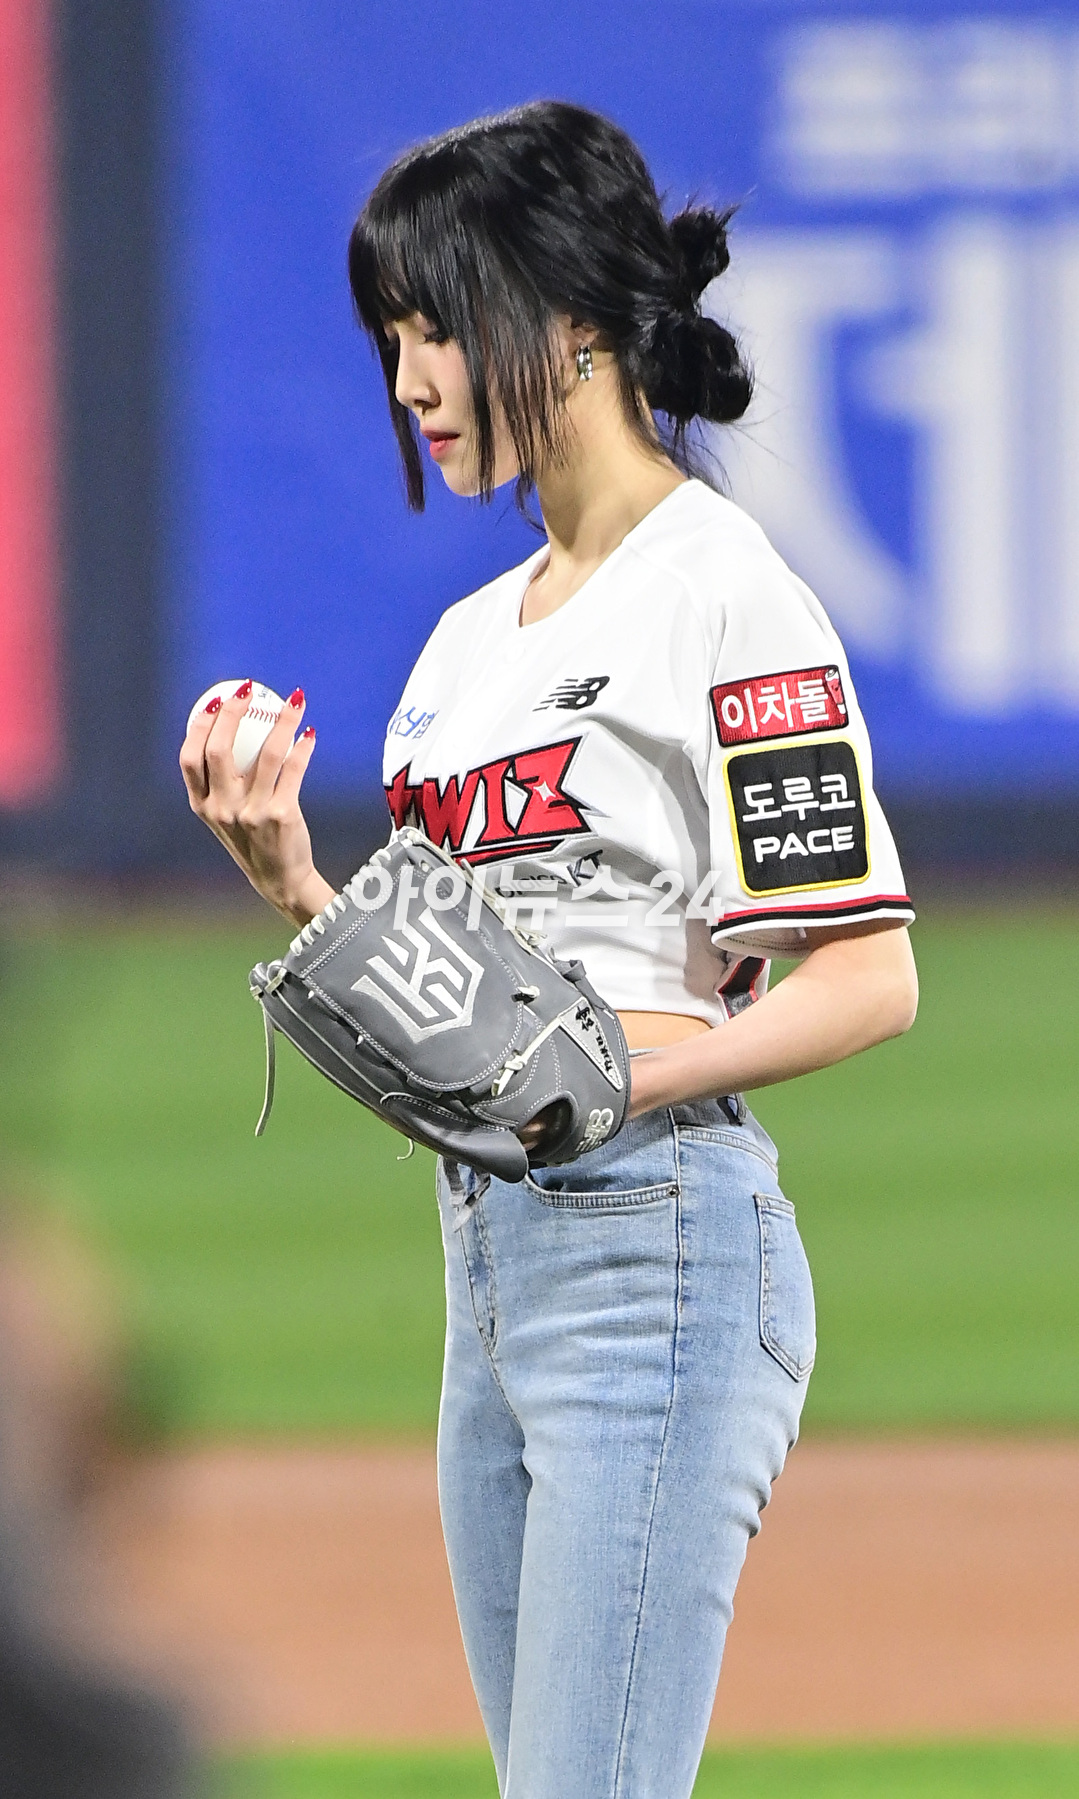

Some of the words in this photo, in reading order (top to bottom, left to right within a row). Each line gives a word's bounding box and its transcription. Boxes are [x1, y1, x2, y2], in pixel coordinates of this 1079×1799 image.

[721, 678, 830, 734] 이차돌
[742, 773, 857, 823] 도루코
[753, 825, 855, 863] PACE
